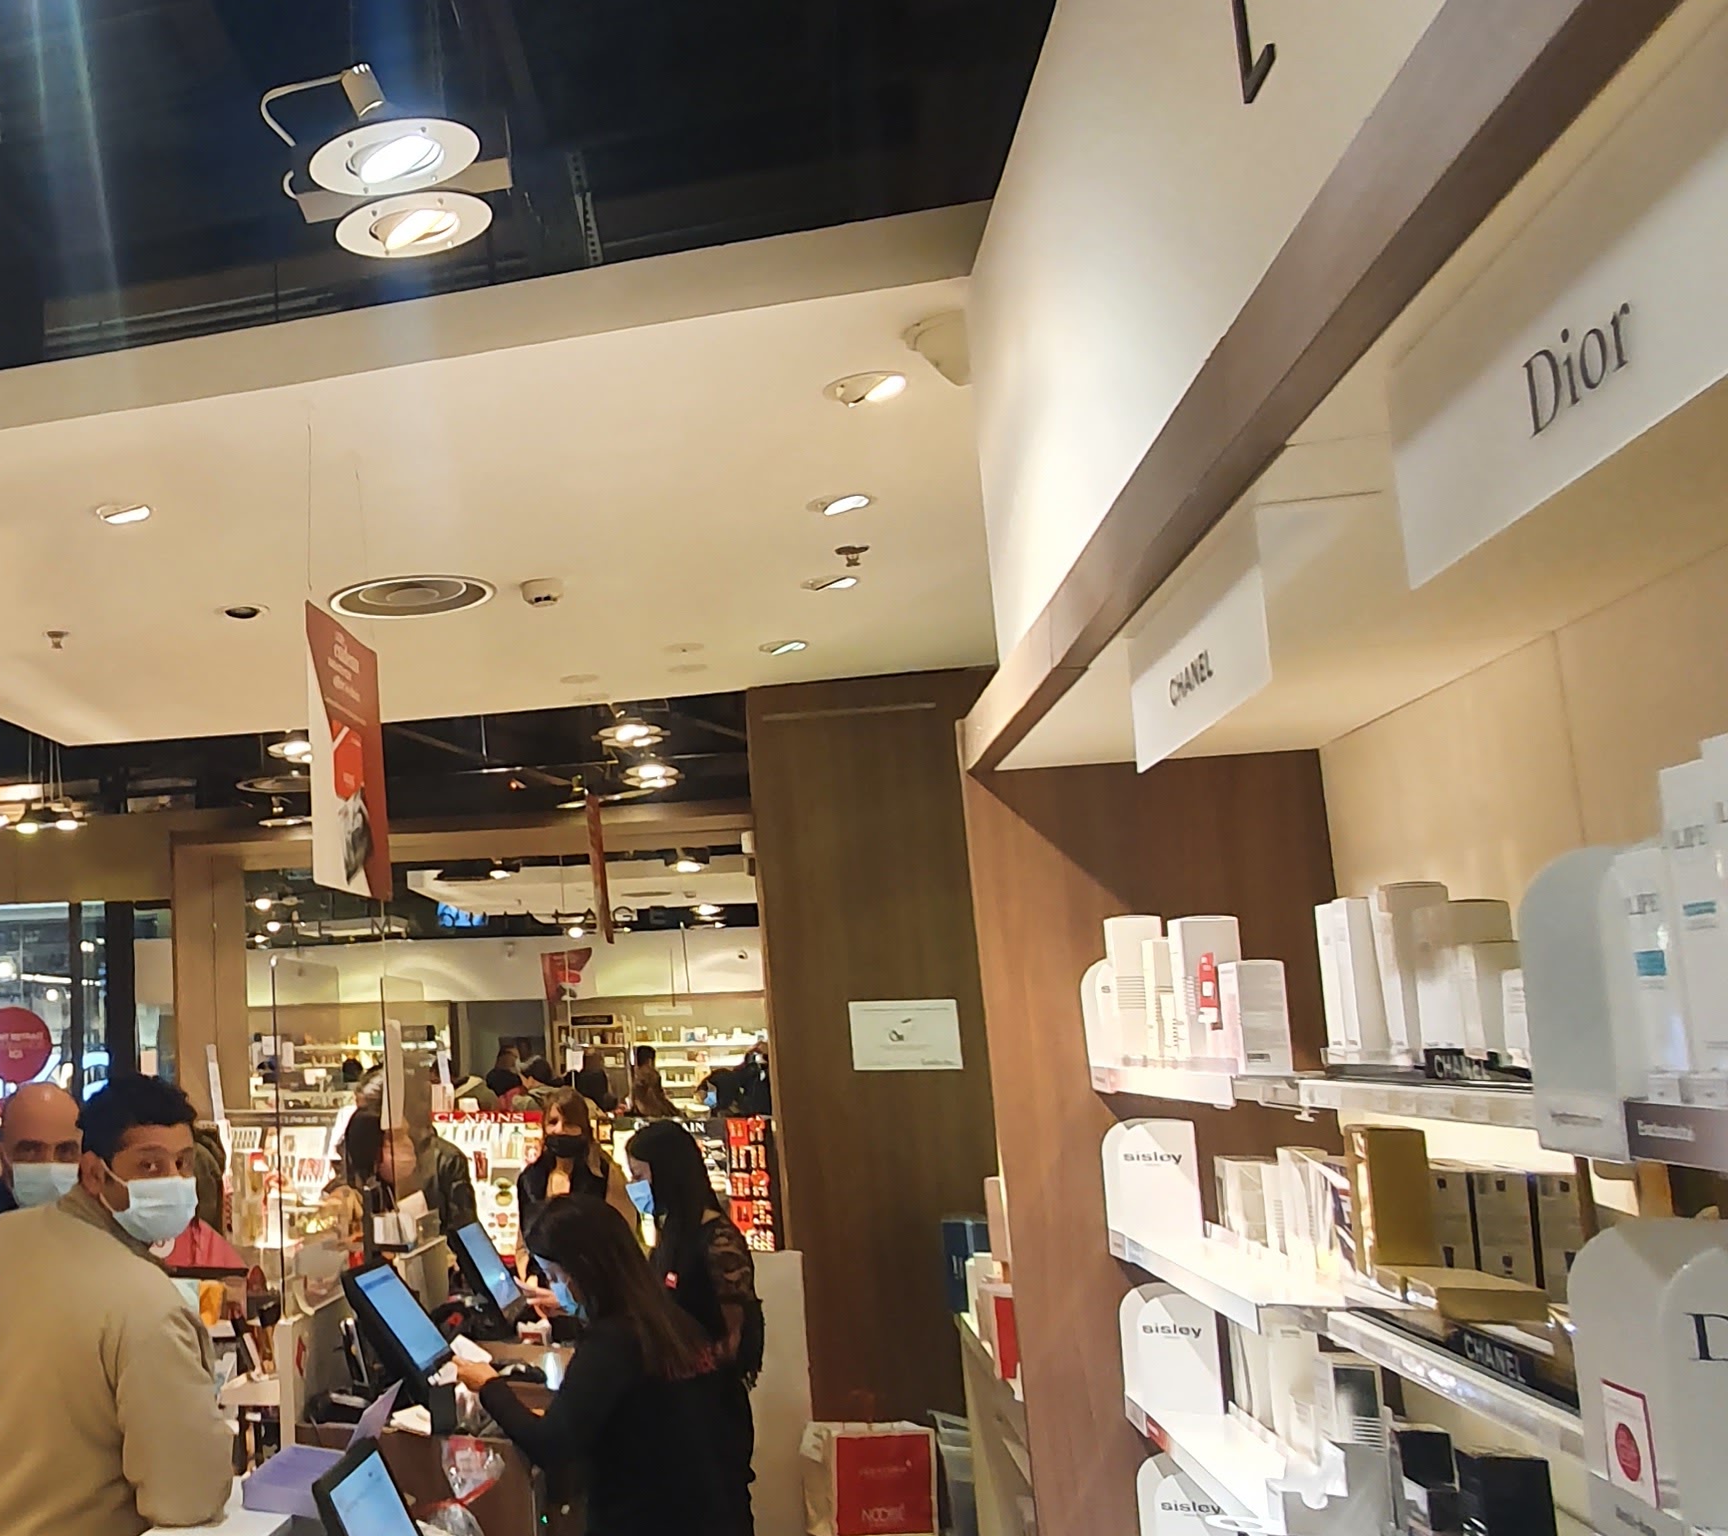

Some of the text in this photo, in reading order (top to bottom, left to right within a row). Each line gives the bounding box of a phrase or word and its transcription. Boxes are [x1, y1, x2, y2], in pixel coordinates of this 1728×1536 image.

[1521, 301, 1632, 439] Dior
[1168, 648, 1215, 708] CHANEL
[433, 1113, 524, 1123] CLARINS
[1123, 1150, 1183, 1165] sisley
[1142, 1322, 1203, 1339] sisley
[1463, 1331, 1527, 1384] CHANEL
